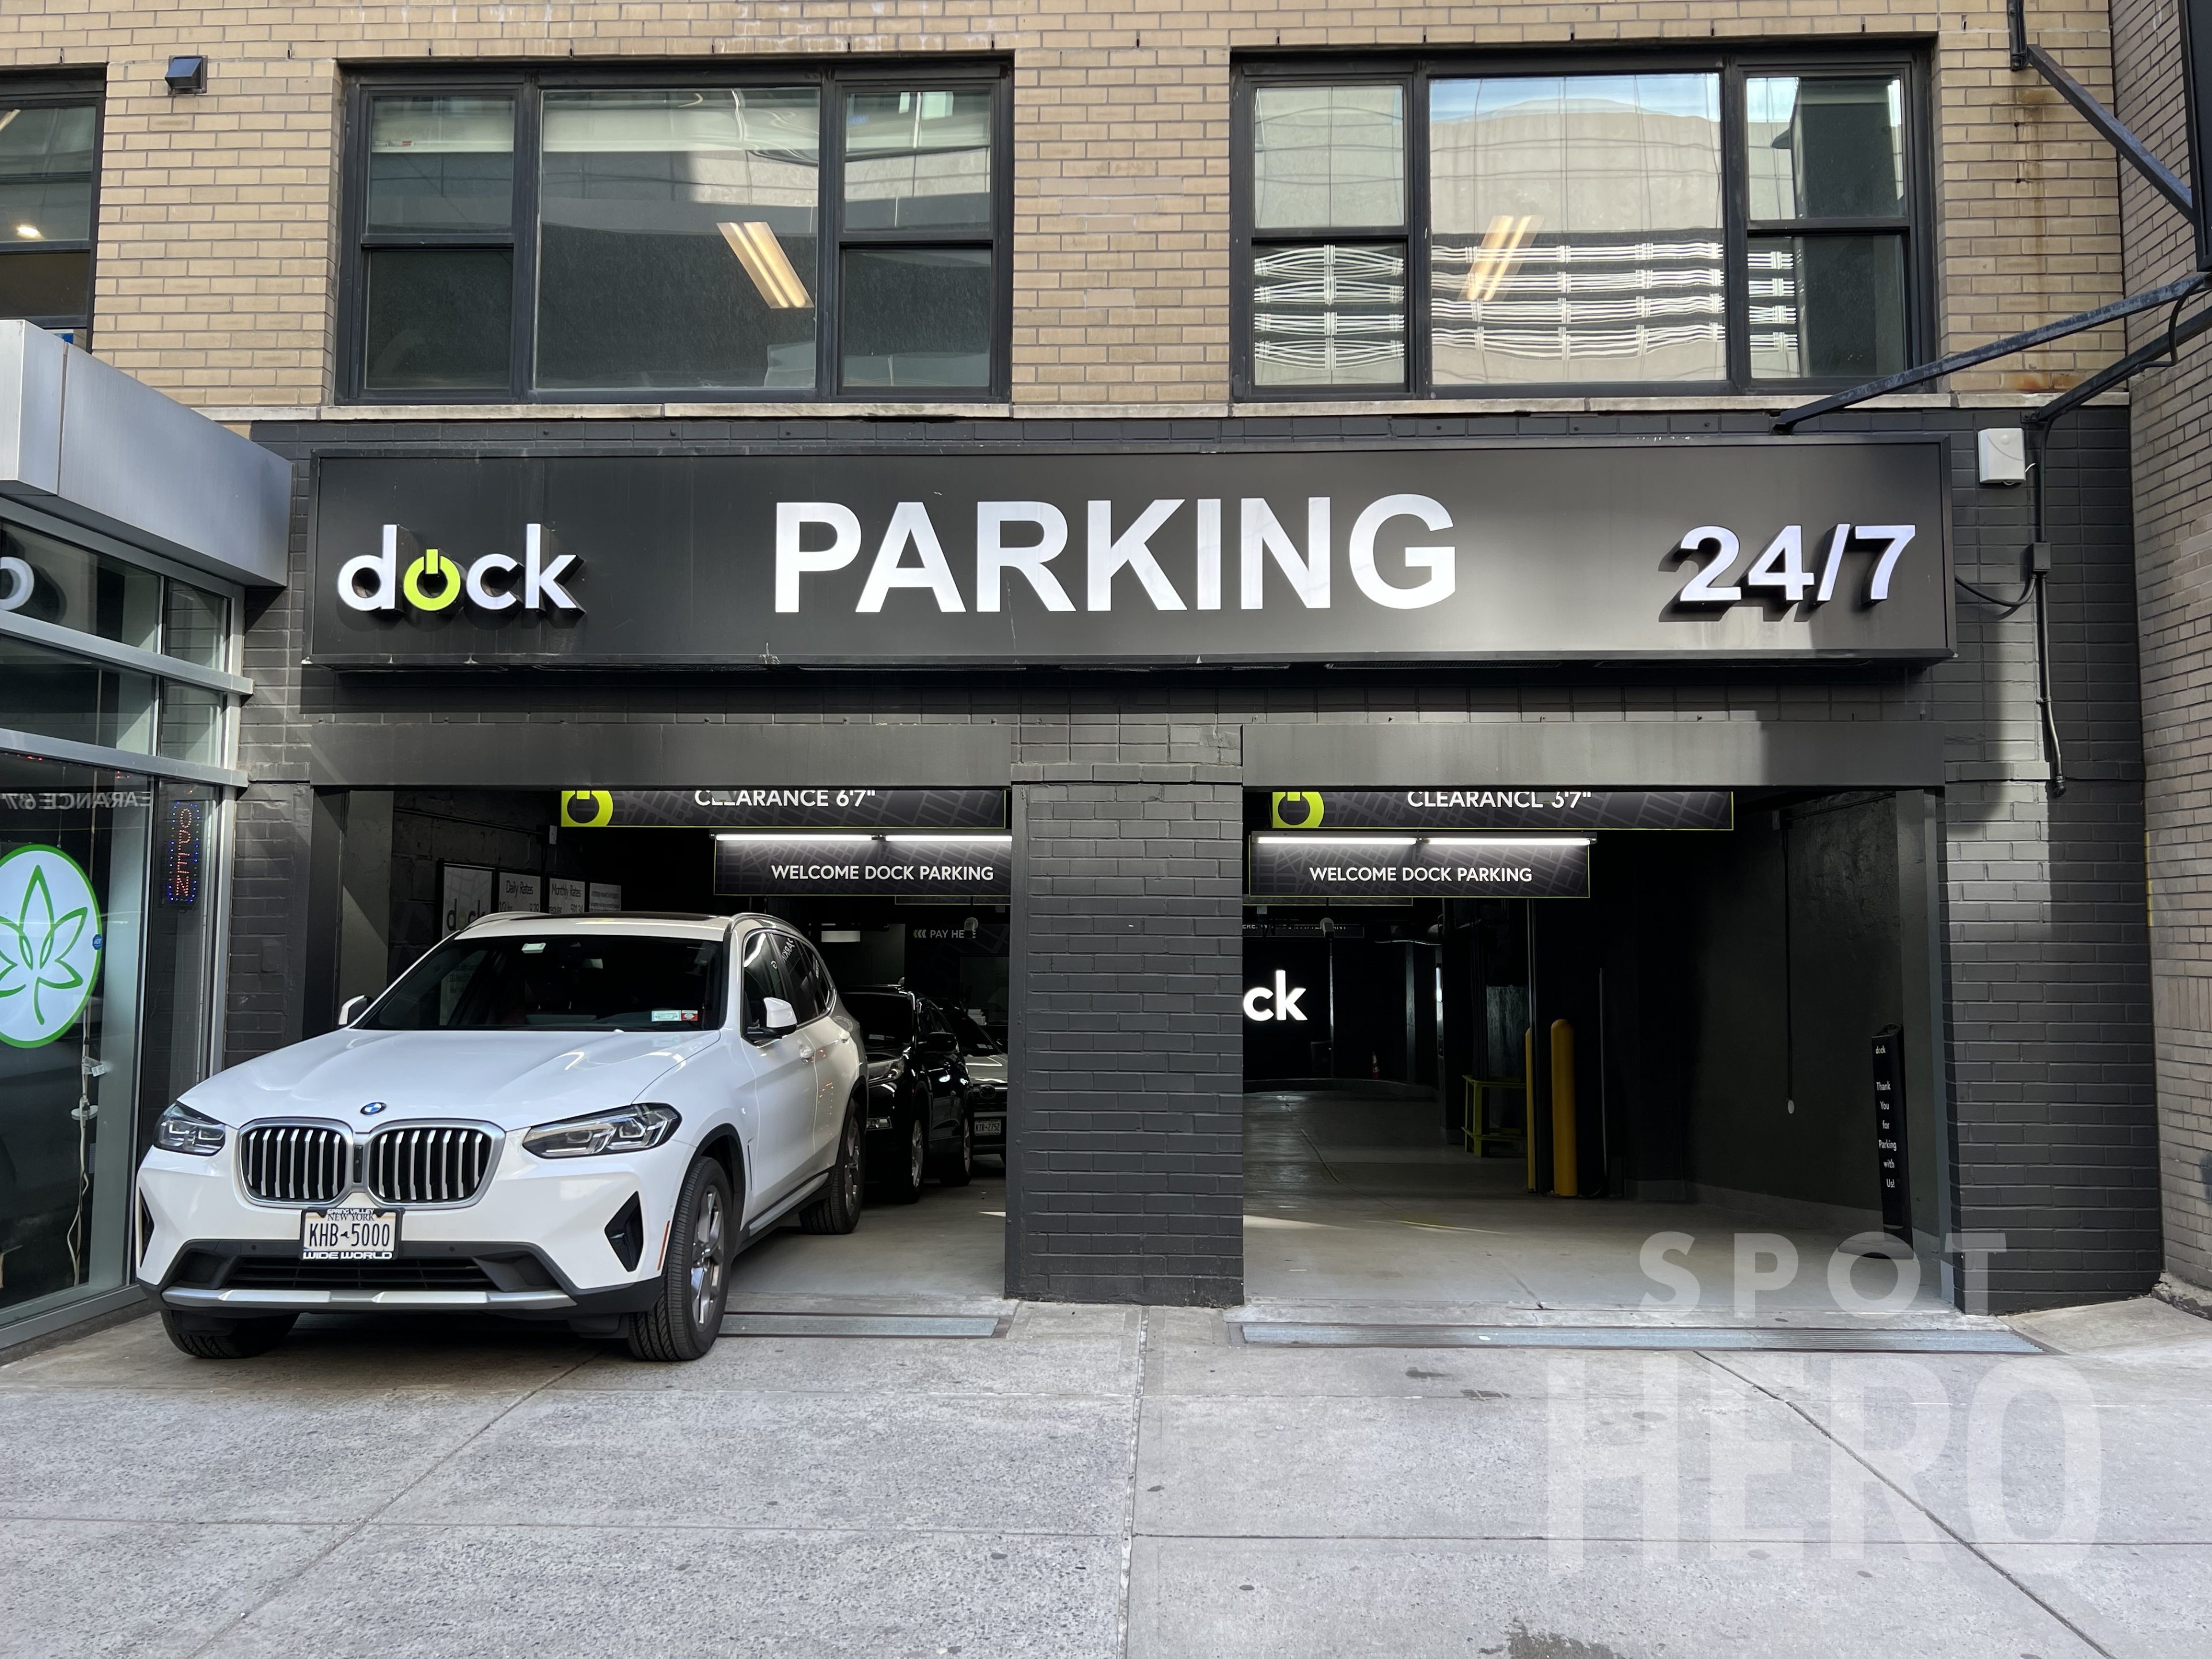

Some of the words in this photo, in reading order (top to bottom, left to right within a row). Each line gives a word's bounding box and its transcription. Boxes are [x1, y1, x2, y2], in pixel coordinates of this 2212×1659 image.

[775, 494, 1456, 613] PARKING
[338, 523, 578, 611] dock
[1680, 523, 1916, 601] 24/7
[694, 791, 829, 806] CARANCE
[176, 808, 192, 897] OPEN
[771, 865, 859, 880] WELCOME
[865, 866, 915, 880] DOCK
[920, 866, 994, 881] PARKING
[1309, 866, 1397, 881] WELCOME
[1402, 867, 1452, 881] DOCK
[1457, 867, 1532, 882] PARKING
[506, 880, 518, 898] Daily
[930, 929, 949, 938] PAY
[951, 929, 976, 938] HEE
[1875, 1045, 1886, 1054] dock
[1876, 1081, 1891, 1091] Thank
[1880, 1101, 1890, 1111] You
[1882, 1120, 1890, 1130] for
[1878, 1139, 1897, 1152] Parking
[1883, 1158, 1895, 1169] with
[1886, 1179, 1895, 1188] Us!
[327, 1213, 349, 1221] NEW
[351, 1213, 375, 1221] YORK
[309, 1224, 339, 1247] KHB
[351, 1223, 390, 1247] 5000
[302, 1251, 339, 1260] WIDE
[340, 1251, 393, 1260] WORLD
